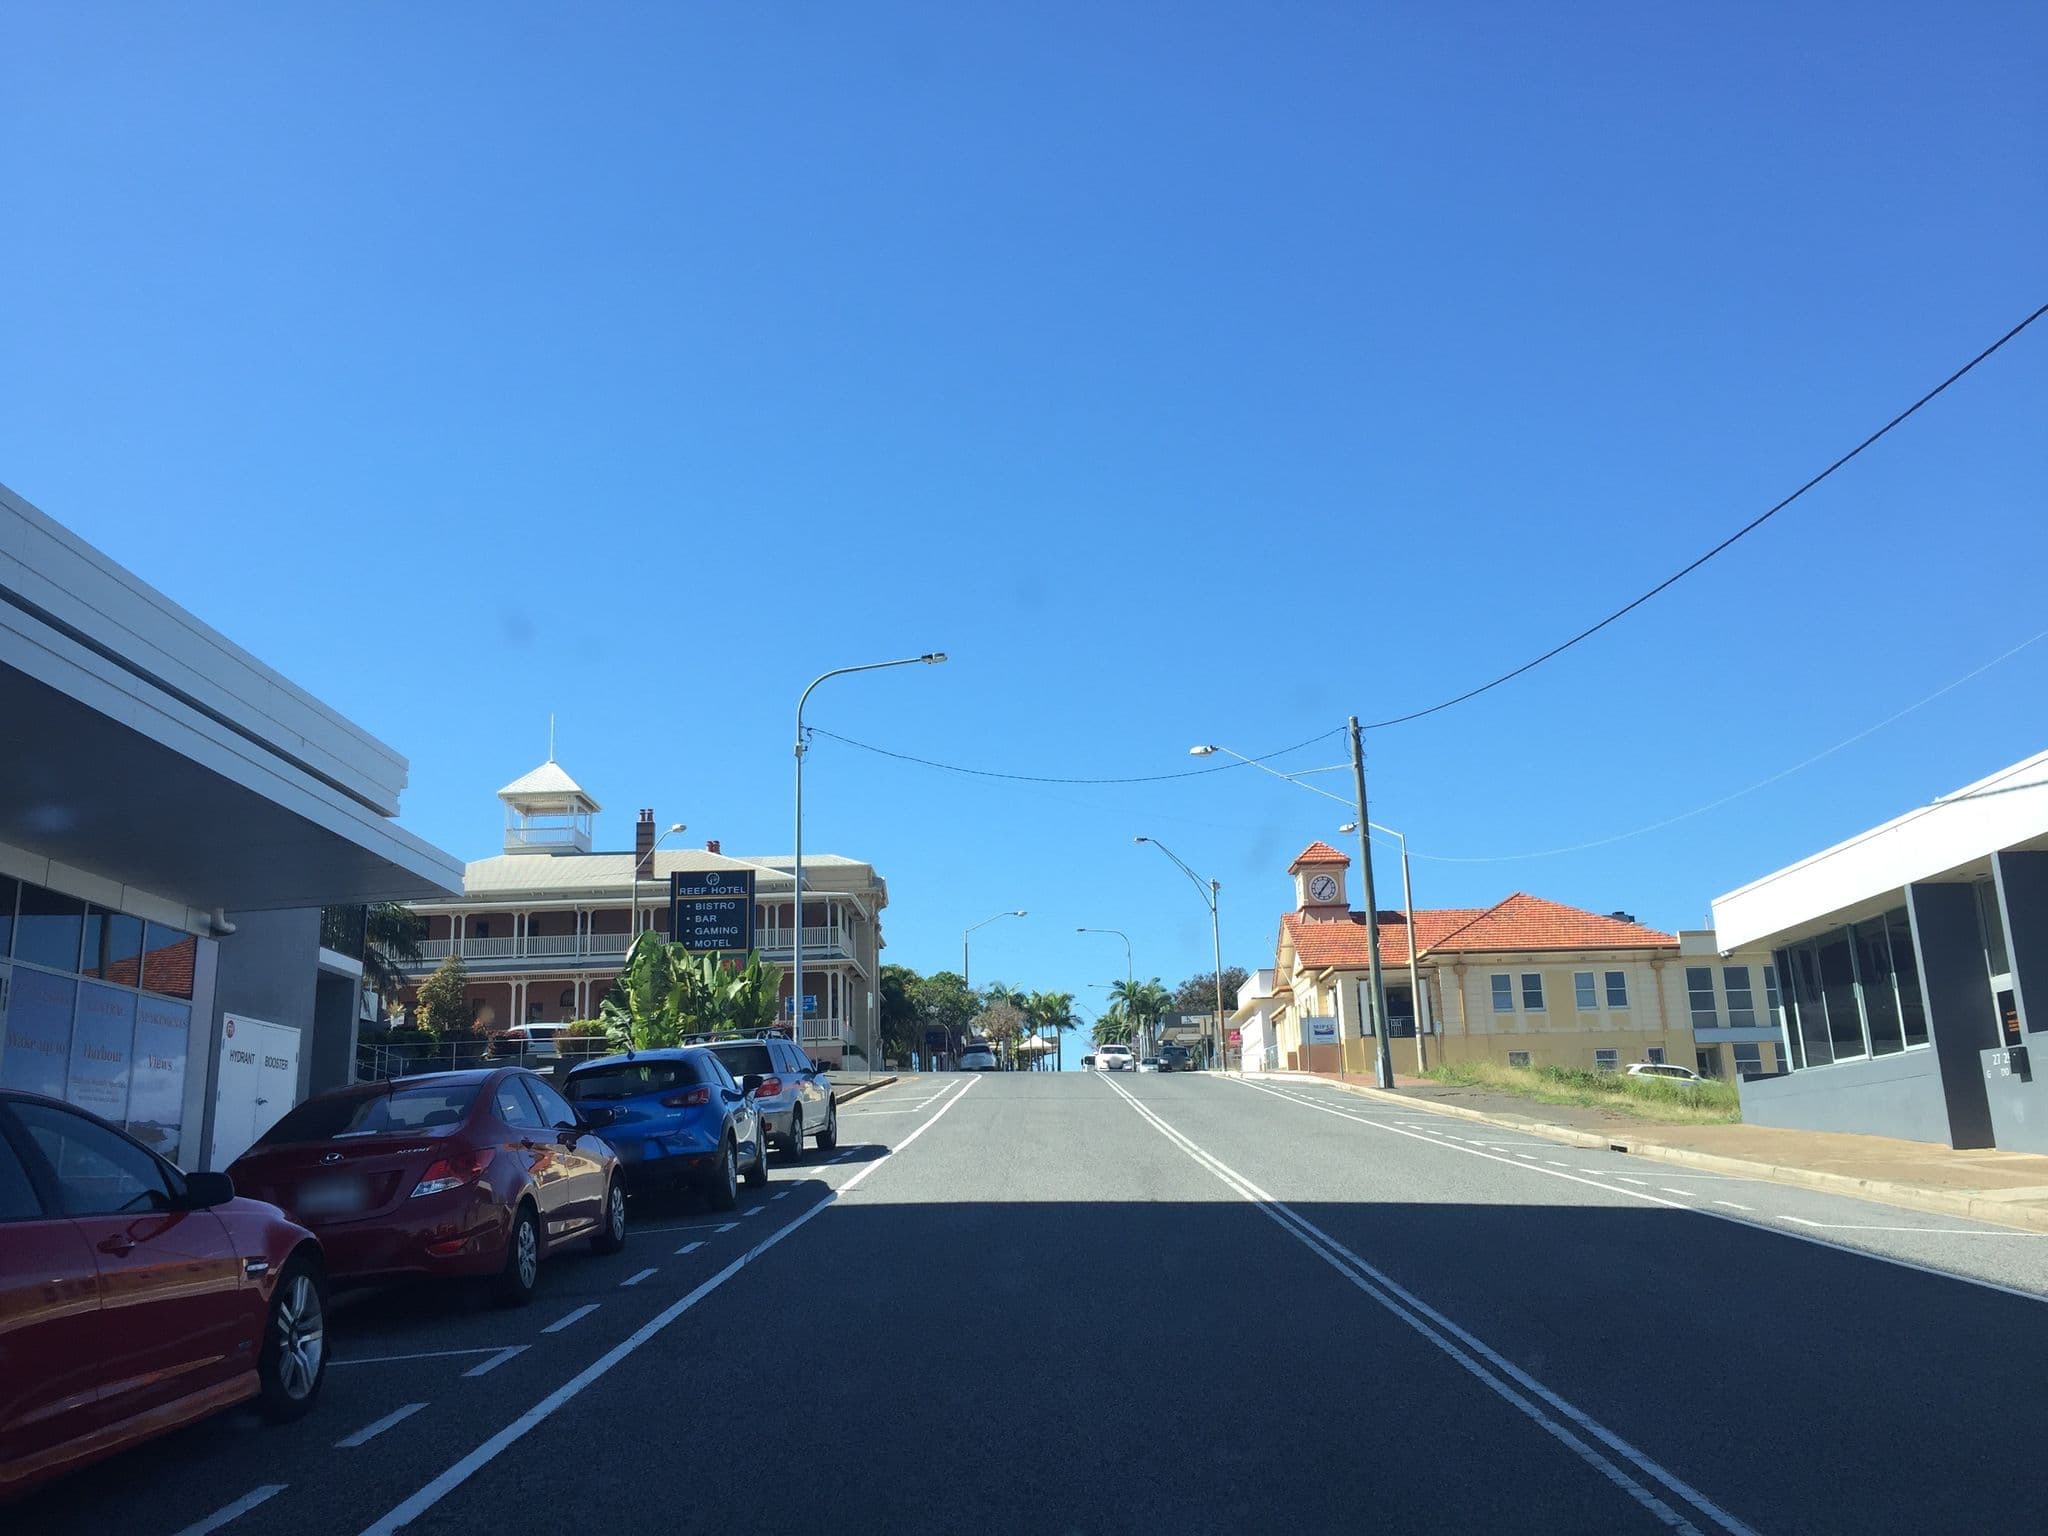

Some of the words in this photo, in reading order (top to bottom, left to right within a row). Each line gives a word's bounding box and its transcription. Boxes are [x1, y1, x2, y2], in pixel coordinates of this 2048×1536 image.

[680, 887, 707, 895] REEF
[711, 886, 746, 894] HOTEL
[695, 902, 736, 911] BISTRO
[695, 915, 717, 923] BAR
[694, 926, 738, 935] GAMING
[694, 939, 731, 948] MOTEL
[147, 1055, 172, 1071] Views
[229, 1049, 256, 1065] HYDRANT
[264, 1055, 289, 1071] BOOSTER
